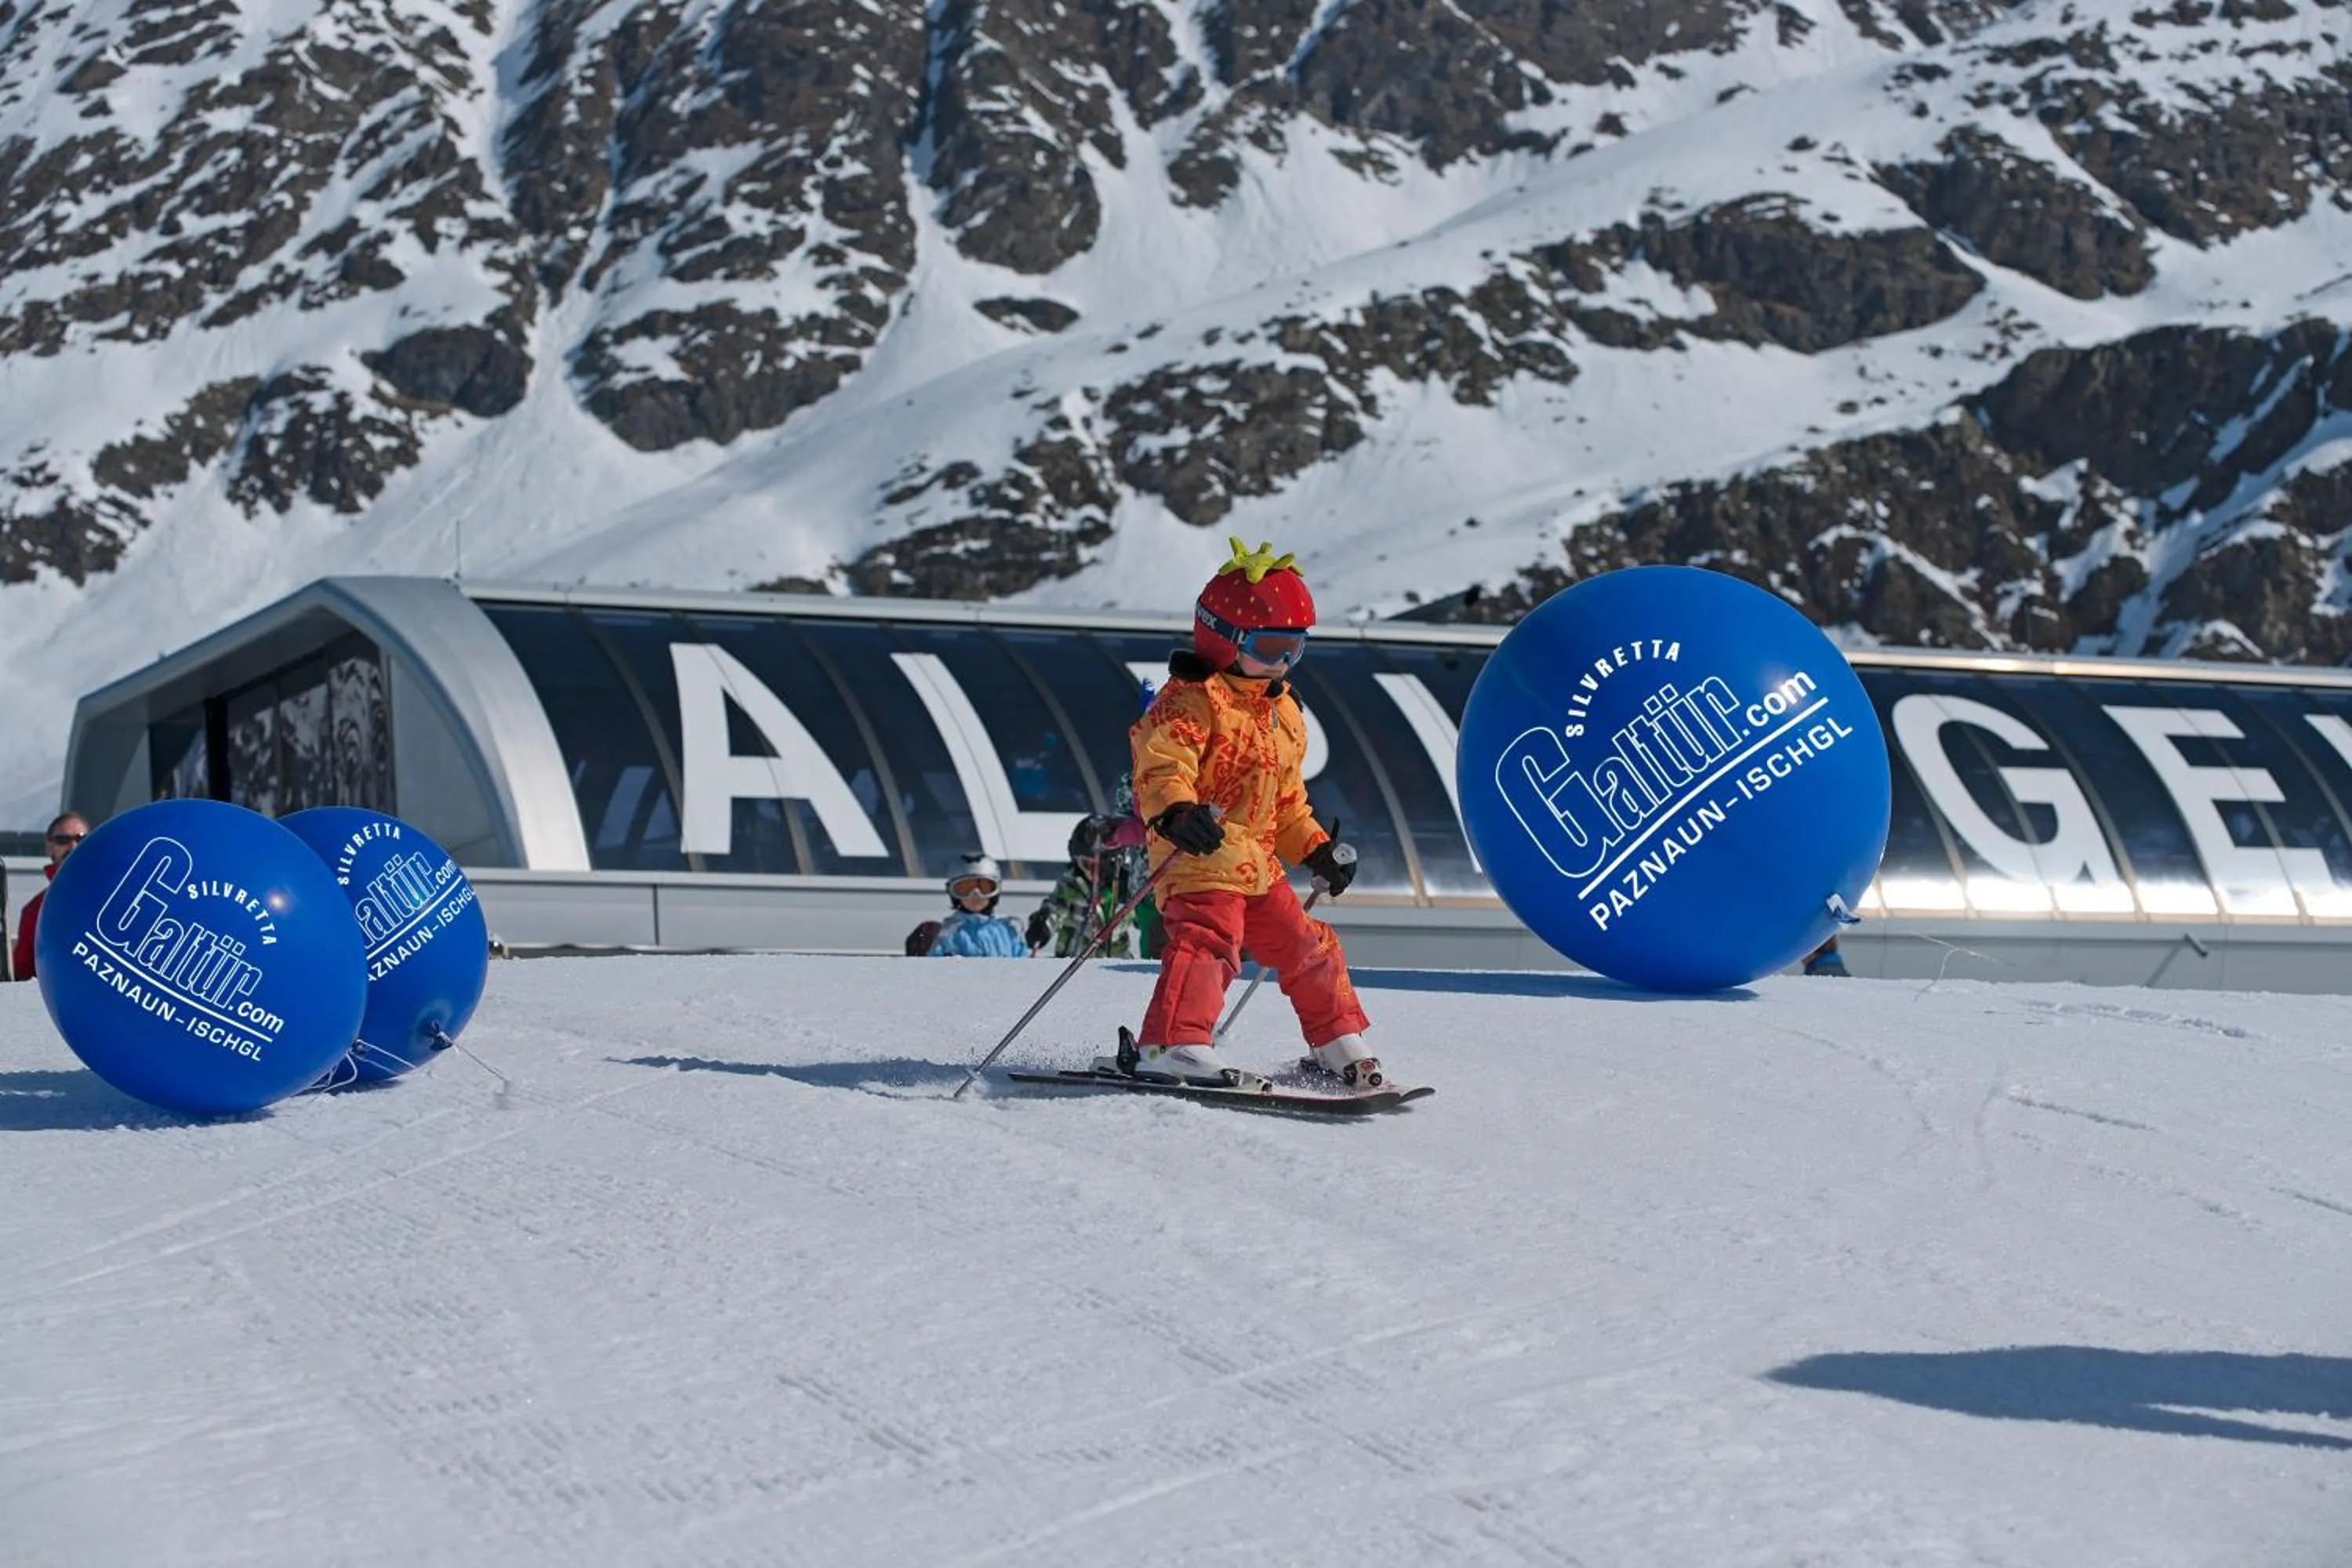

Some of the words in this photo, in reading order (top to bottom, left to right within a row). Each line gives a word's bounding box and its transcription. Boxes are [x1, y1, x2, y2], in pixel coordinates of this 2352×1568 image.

[1566, 639, 1681, 737] SILVRETTA
[336, 822, 401, 886] SILVRETTA
[1588, 717, 1853, 931] PAZNAUN-ISCHGL
[187, 880, 277, 946] SILVRETTA
[355, 851, 457, 949] altür.com
[367, 884, 477, 982] ZNAUN-ISCHGL
[72, 941, 262, 1062] PAZNAUN-ISCHGL
